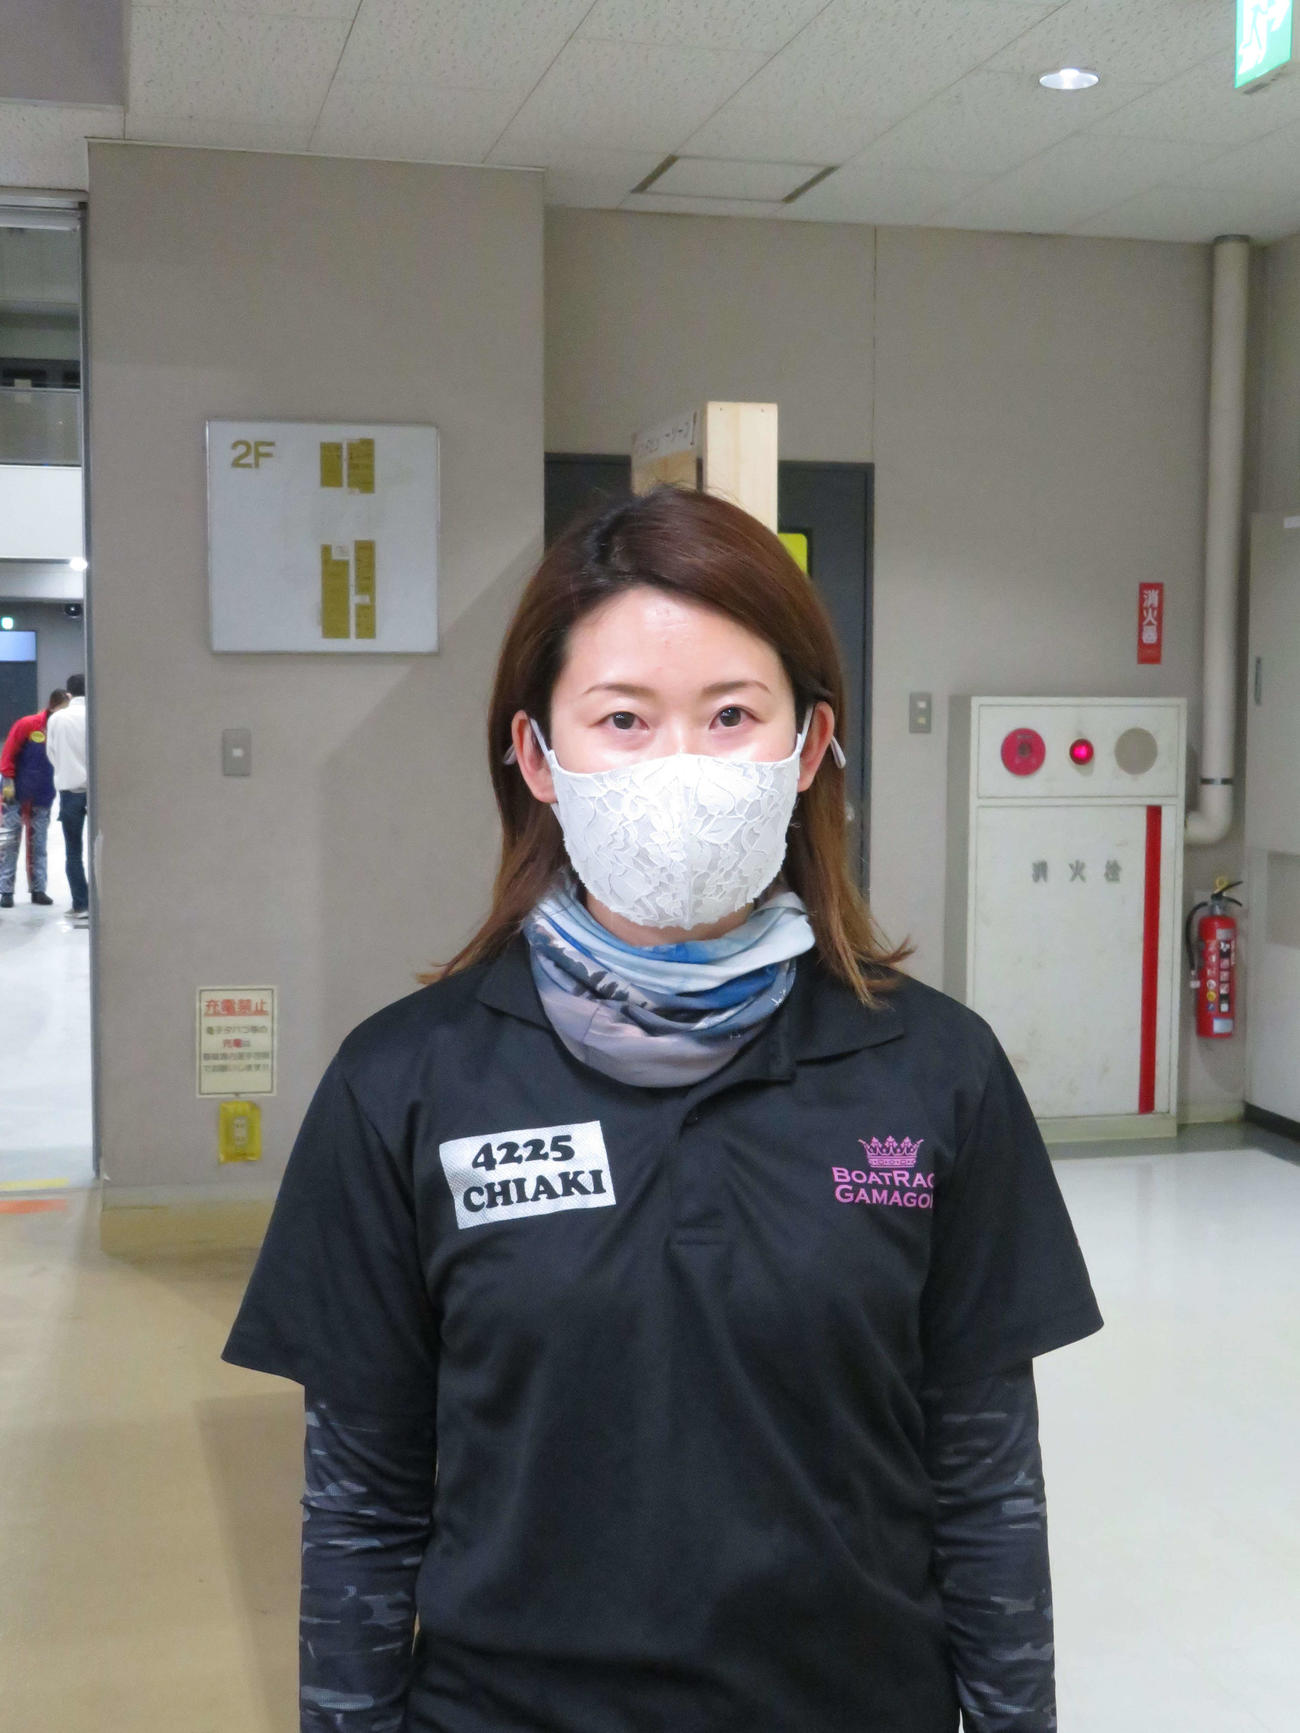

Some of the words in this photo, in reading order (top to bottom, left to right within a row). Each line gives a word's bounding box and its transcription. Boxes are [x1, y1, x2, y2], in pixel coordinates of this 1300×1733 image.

[231, 440, 275, 468] 2F
[472, 1135, 575, 1171] 4225
[463, 1169, 606, 1212] CHIAKI
[835, 1185, 934, 1208] GAMAGO
